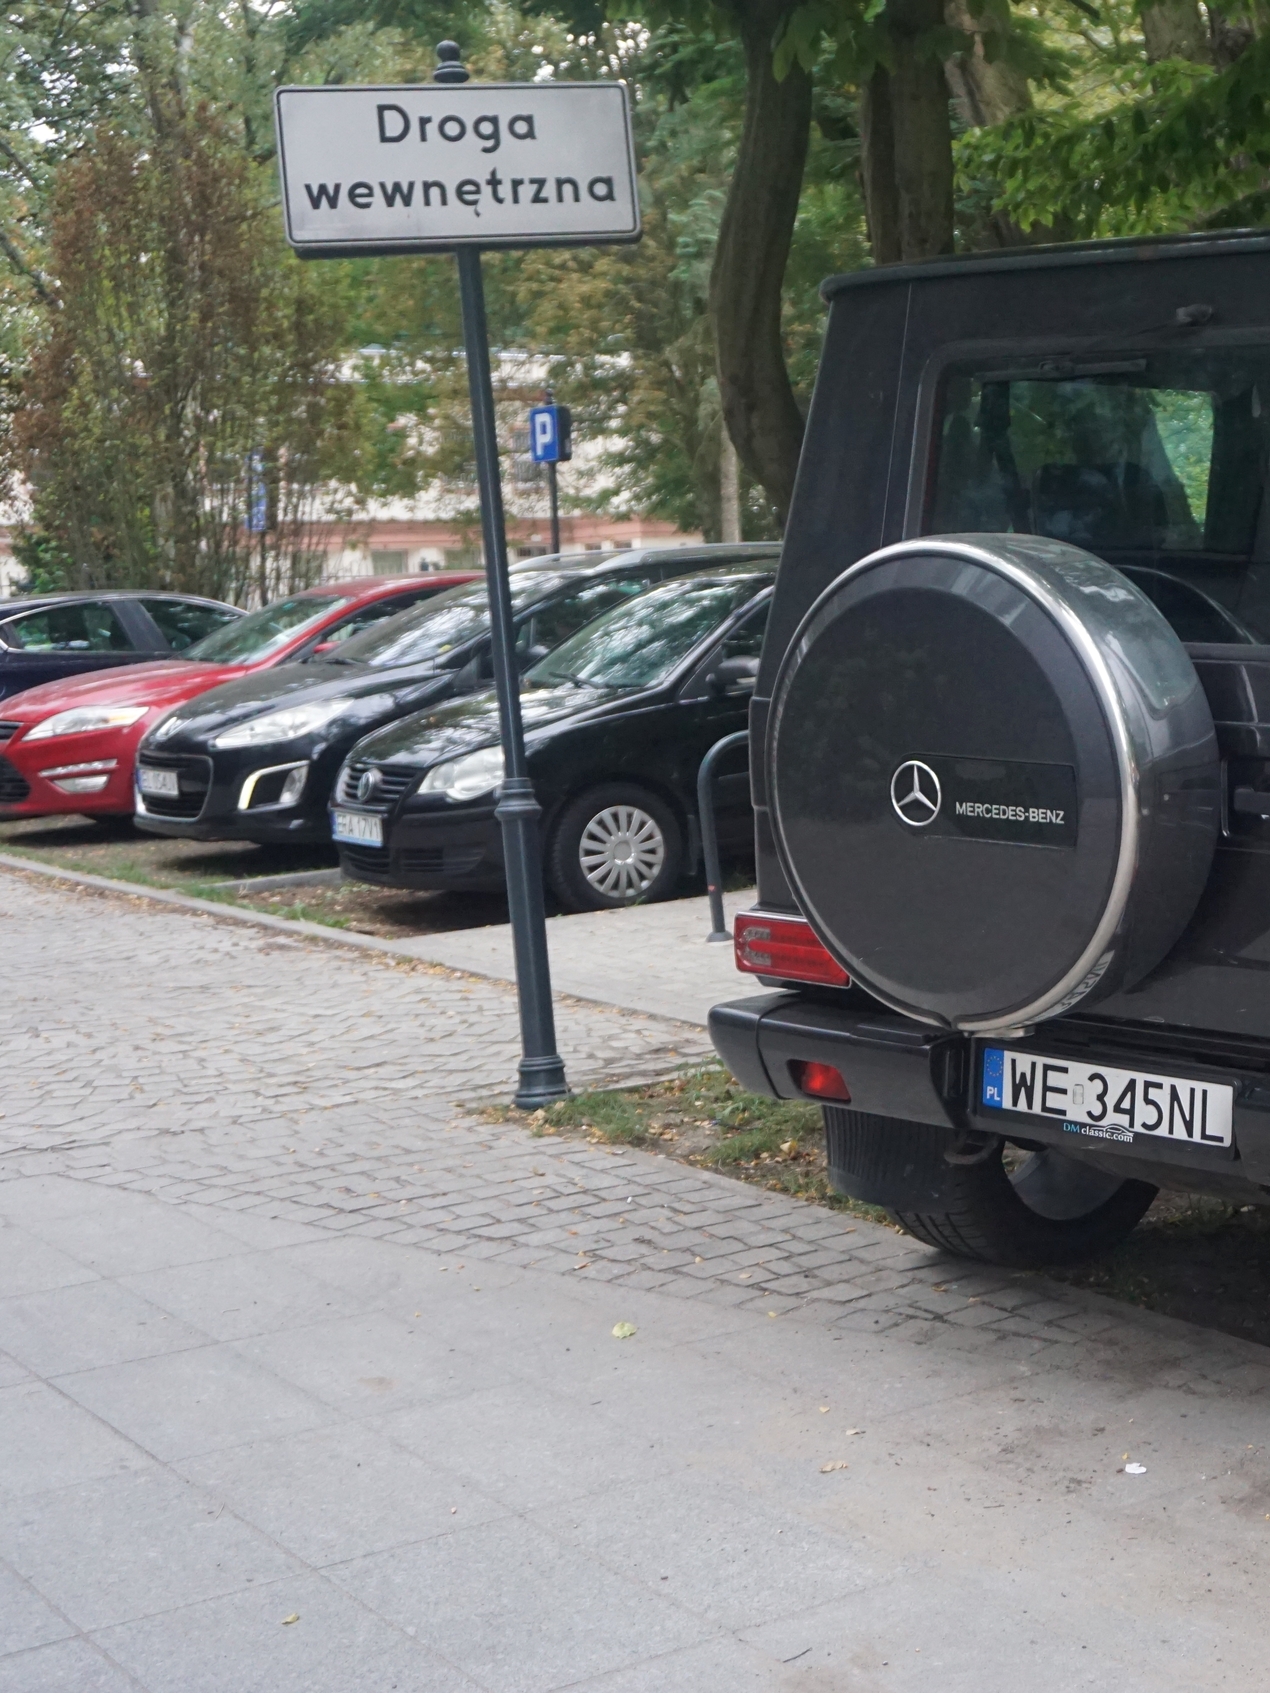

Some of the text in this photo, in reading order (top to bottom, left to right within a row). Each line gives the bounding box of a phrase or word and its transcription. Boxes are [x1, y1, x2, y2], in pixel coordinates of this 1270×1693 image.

[376, 103, 537, 153] Droga
[304, 167, 617, 217] wewnętrzna
[535, 413, 552, 456] P
[955, 801, 1065, 824] MERCEDES-BENZ
[986, 1085, 1001, 1101] PL
[1010, 1057, 1225, 1143] WE 345NL
